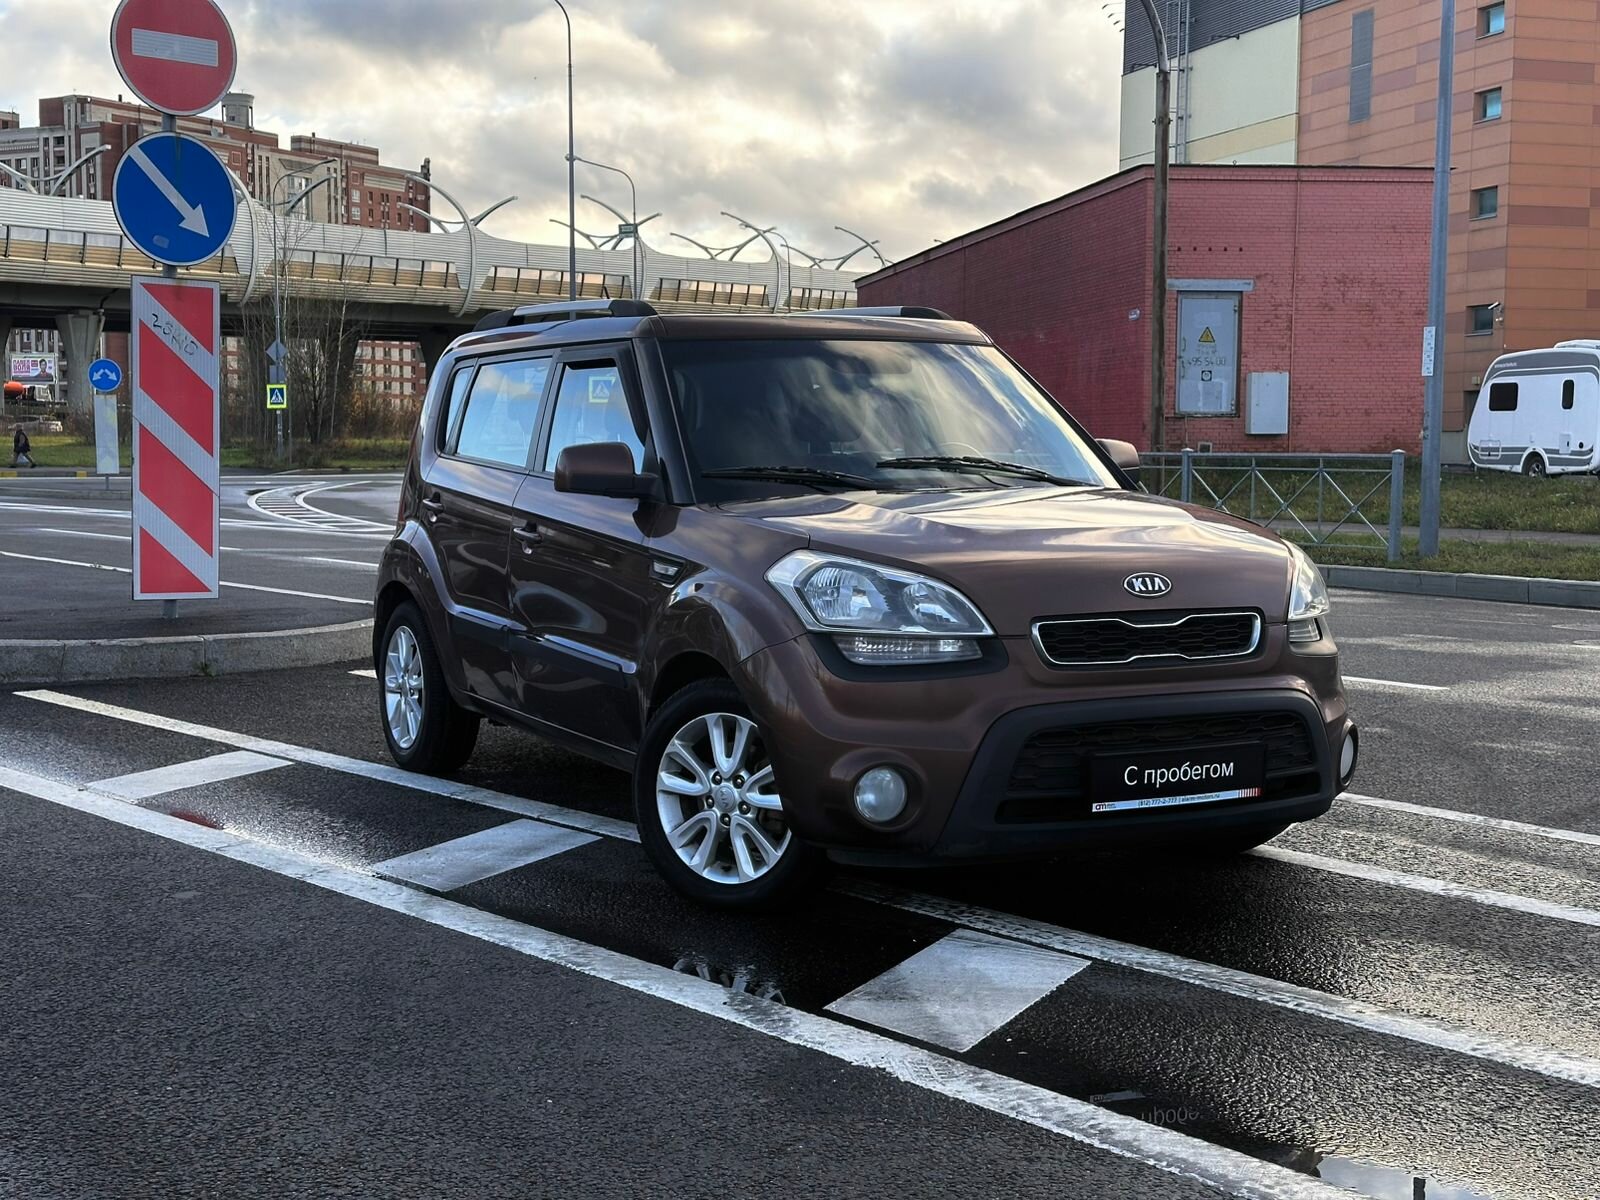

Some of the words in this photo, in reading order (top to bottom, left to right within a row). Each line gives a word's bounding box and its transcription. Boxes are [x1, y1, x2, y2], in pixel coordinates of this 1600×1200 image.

[1131, 576, 1166, 592] KIA
[1123, 765, 1139, 786] С
[1143, 761, 1235, 789] пробегом
